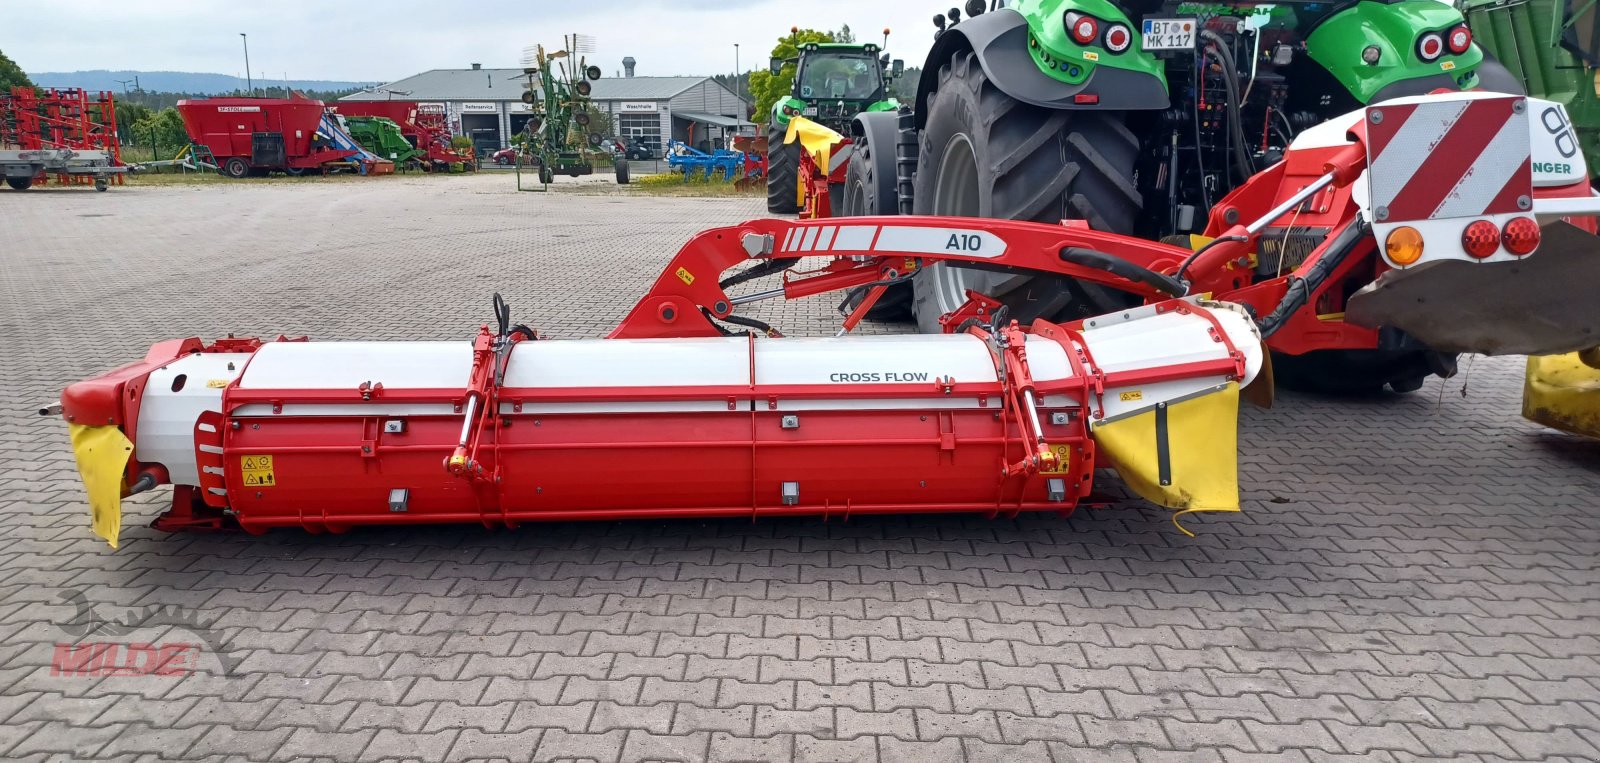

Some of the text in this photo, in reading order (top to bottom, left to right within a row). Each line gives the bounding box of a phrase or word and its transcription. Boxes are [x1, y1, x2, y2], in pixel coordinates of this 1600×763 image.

[1153, 22, 1170, 35] BT
[1147, 34, 1191, 47] MK 117
[803, 87, 811, 95] 50
[945, 233, 982, 252] A10
[830, 372, 928, 383] CROSS FLOW
